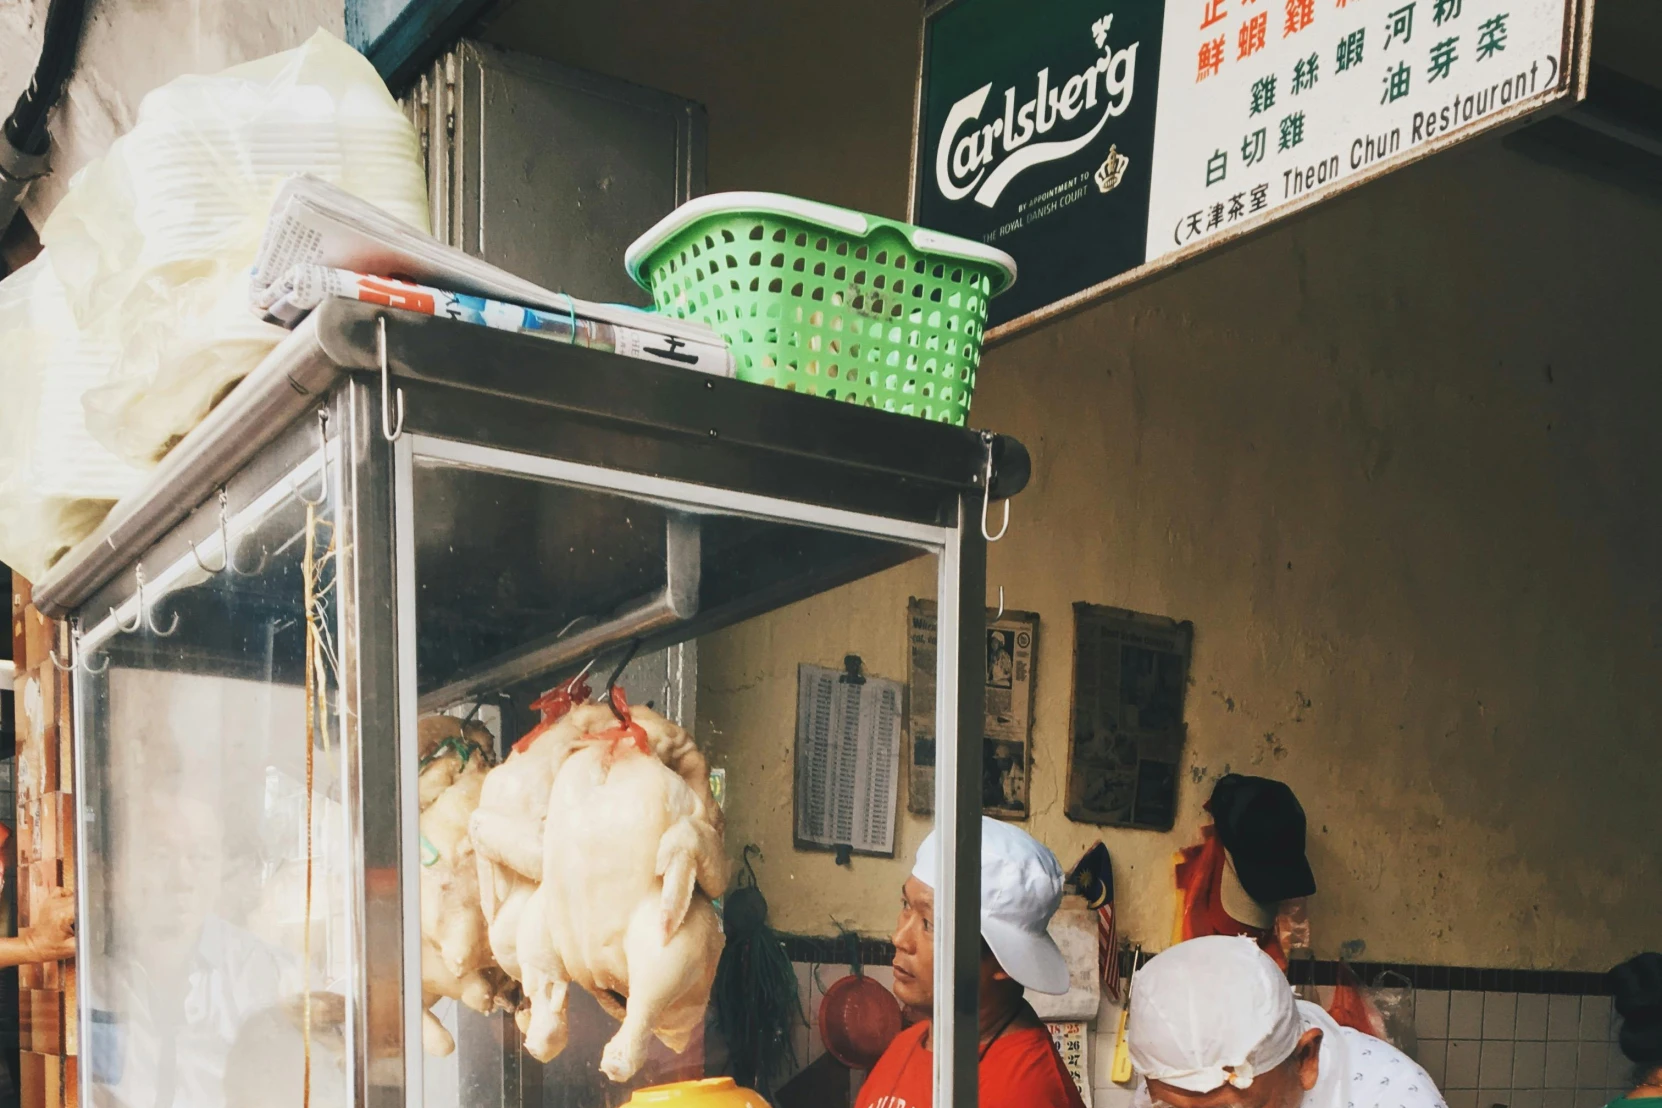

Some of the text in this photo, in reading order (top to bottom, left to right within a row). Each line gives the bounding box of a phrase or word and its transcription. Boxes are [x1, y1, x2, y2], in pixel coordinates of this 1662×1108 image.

[936, 41, 1140, 201] Carlsberg
[1205, 12, 1510, 188] 白切雞 油芽菜
[1283, 154, 1340, 199] Thean
[1350, 127, 1401, 170] Chun
[982, 184, 1088, 243] THE ROYAL DANISH COURT
[1018, 171, 1090, 213] BY APPOINTMENT TO
[1066, 1023, 1080, 1034] 25
[1066, 1040, 1080, 1050] 26
[1067, 1054, 1081, 1067] 27
